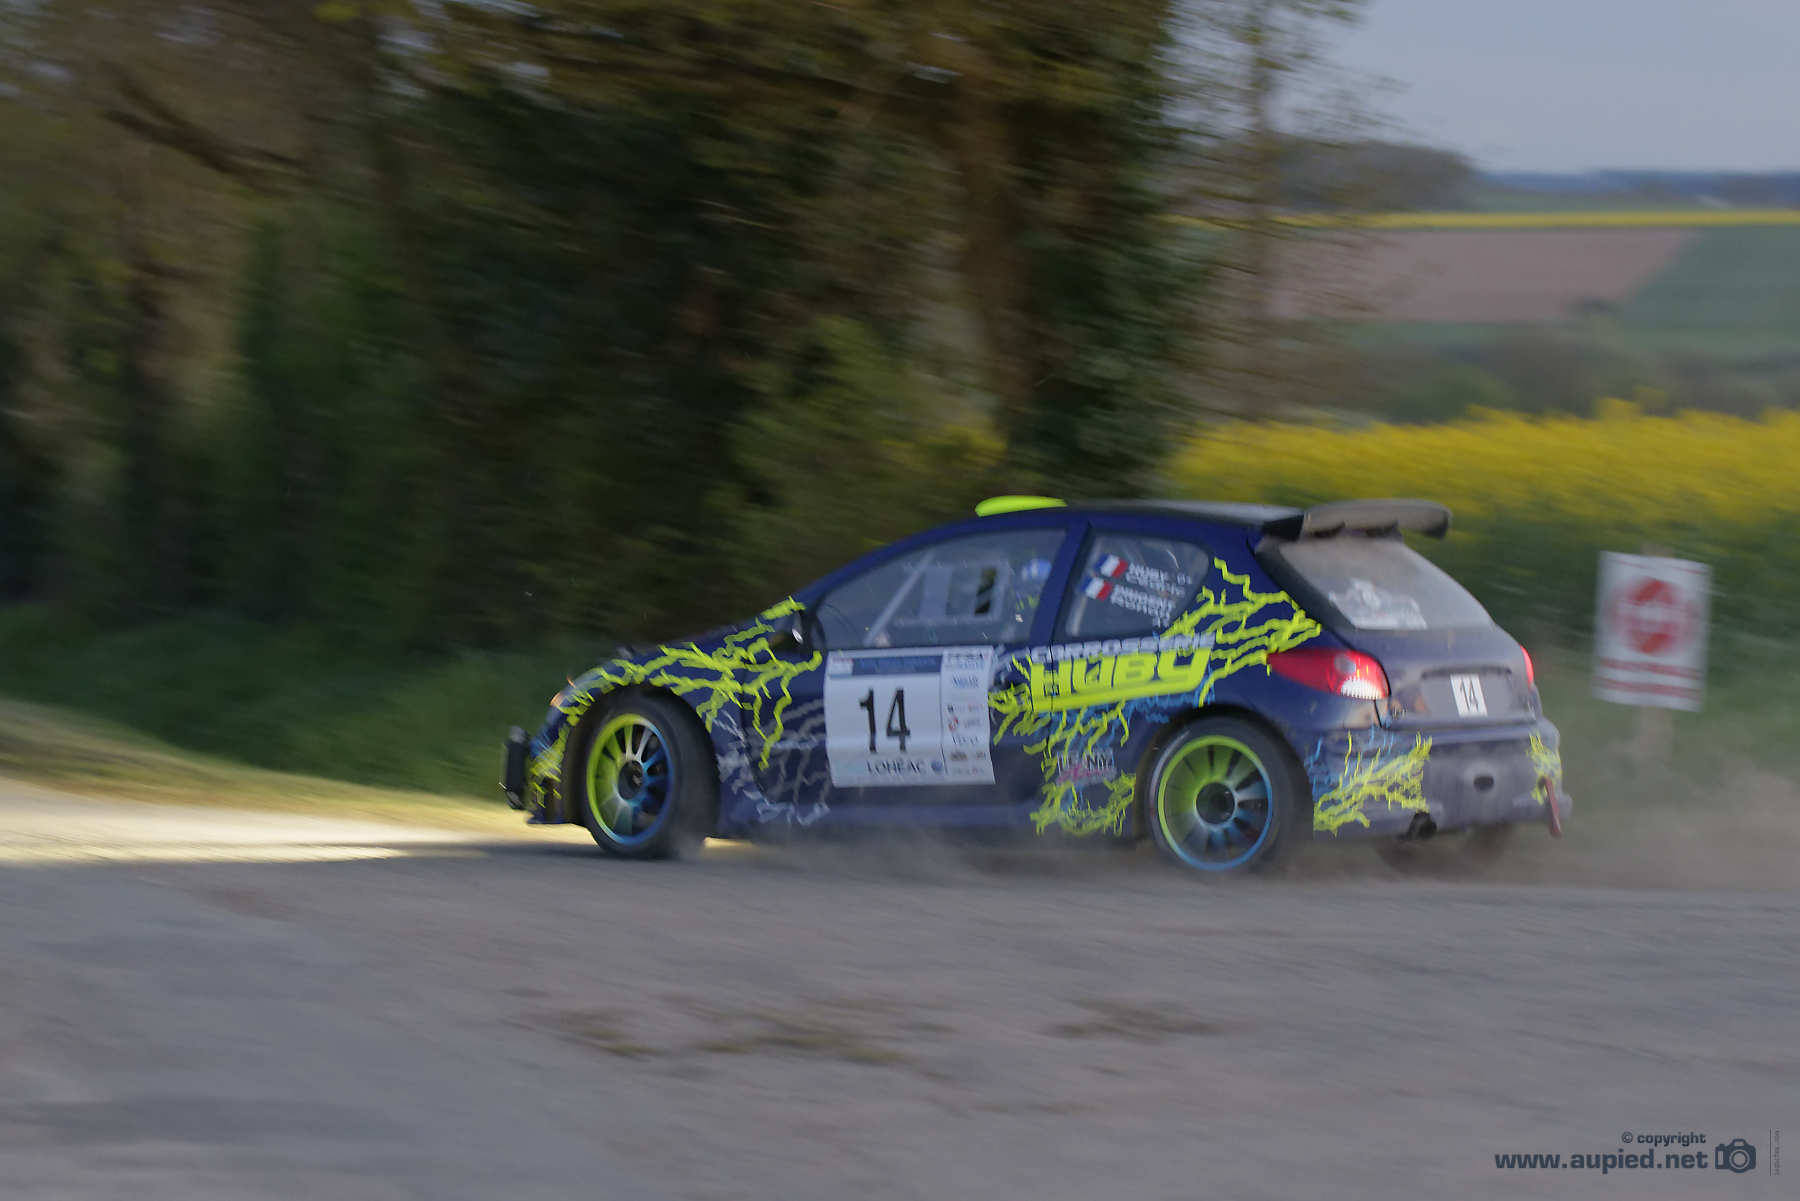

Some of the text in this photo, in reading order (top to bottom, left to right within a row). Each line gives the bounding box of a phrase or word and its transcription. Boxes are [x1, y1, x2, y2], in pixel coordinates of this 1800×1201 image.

[1029, 647, 1213, 709] HUBY
[1459, 678, 1480, 708] 14
[859, 687, 911, 754] 14
